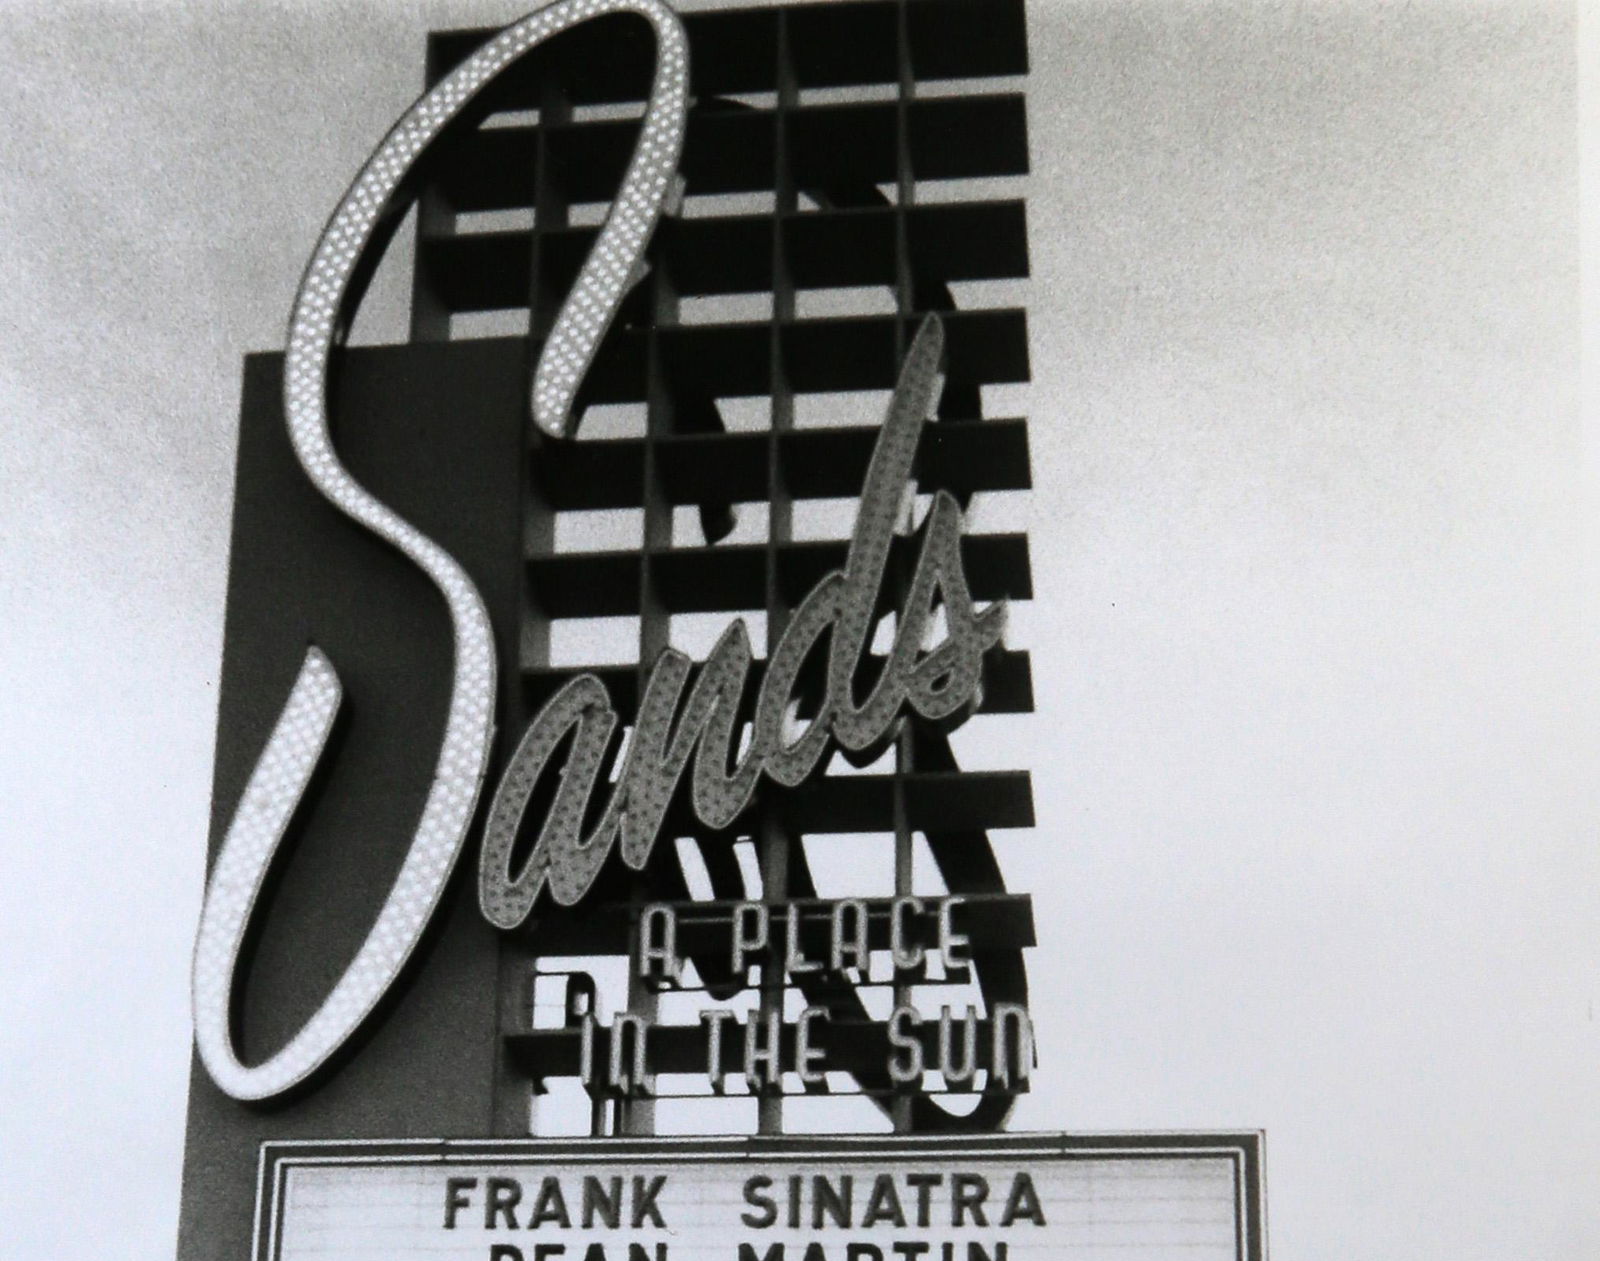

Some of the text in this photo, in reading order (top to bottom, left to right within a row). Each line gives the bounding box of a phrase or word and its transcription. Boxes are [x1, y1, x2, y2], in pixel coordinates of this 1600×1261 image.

[193, 0, 1006, 1102] Sands
[638, 898, 969, 977] A PLACE
[700, 1007, 830, 1088] THE
[443, 1172, 1046, 1229] FRANK SINATRA
